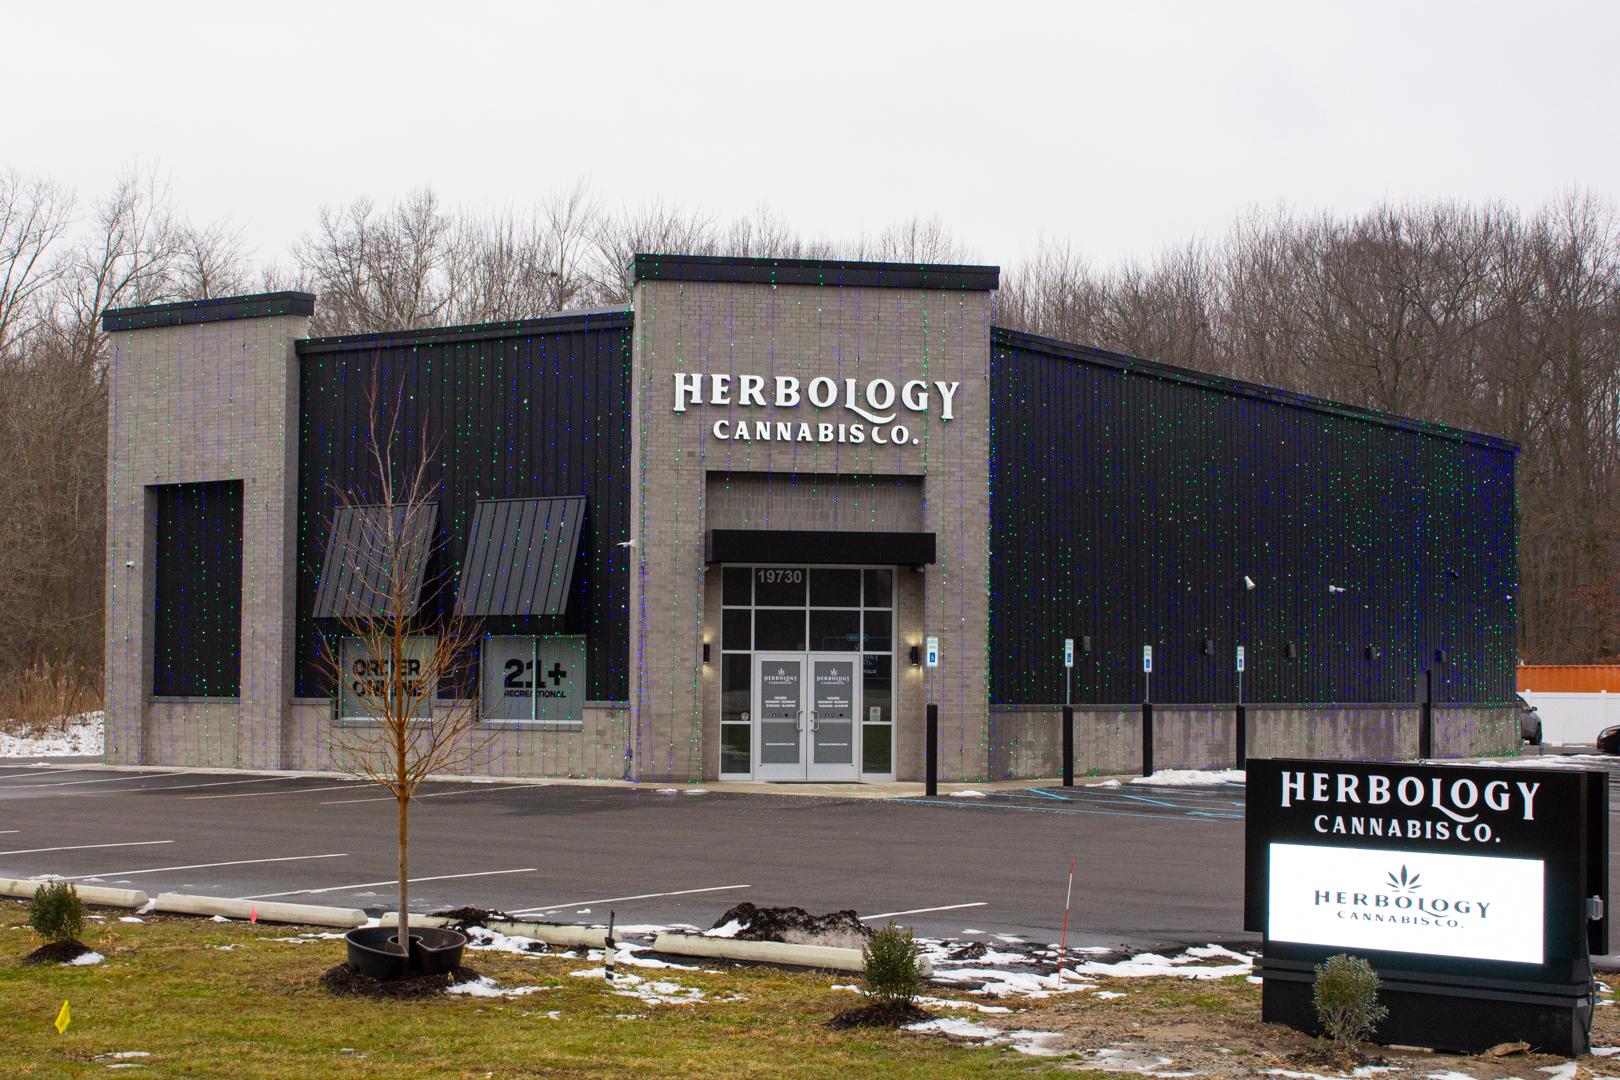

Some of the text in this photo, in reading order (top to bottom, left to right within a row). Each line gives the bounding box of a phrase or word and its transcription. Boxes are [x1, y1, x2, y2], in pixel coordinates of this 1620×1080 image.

[673, 372, 959, 424] HERBOLOGY
[713, 420, 919, 445] CANNABIS CO.
[758, 569, 802, 584] 19730
[504, 659, 567, 688] 21+
[1281, 771, 1541, 823] HERBOLOGY
[1314, 815, 1501, 843] CANNABIS CO.
[1314, 890, 1492, 919] HERBOLOGY
[1337, 911, 1430, 926] CANNABIS
